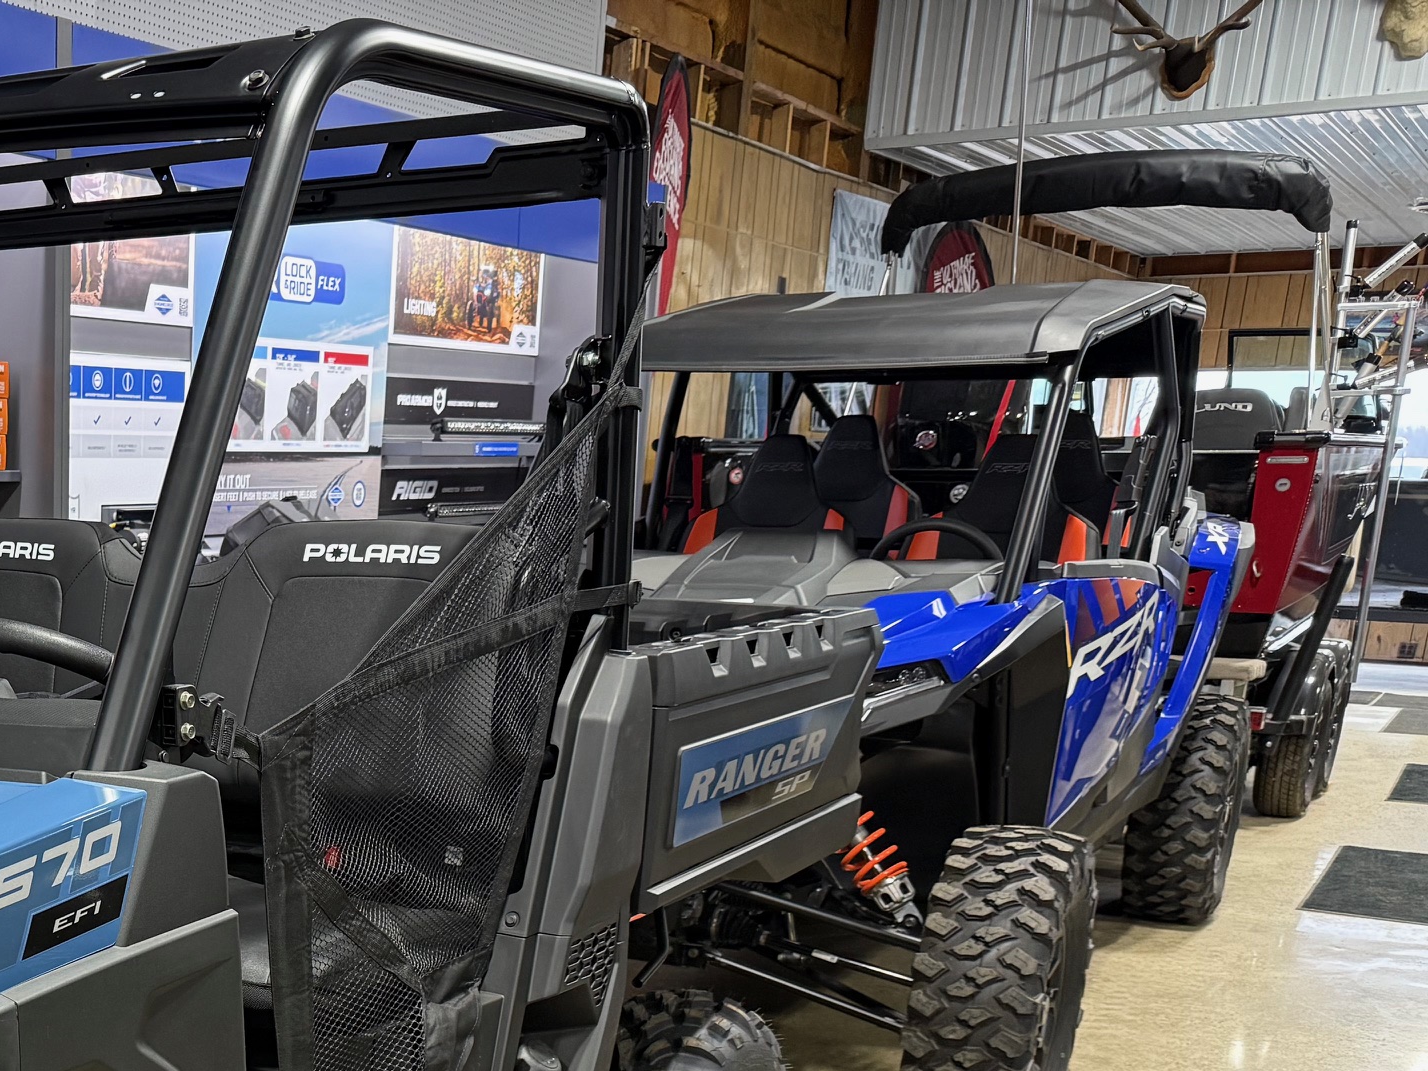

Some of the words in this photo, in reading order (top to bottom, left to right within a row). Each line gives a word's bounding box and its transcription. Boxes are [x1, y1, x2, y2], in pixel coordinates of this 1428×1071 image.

[284, 262, 312, 279] LOCK
[318, 275, 342, 292] FLEX
[404, 298, 436, 316] LIGHTING
[227, 475, 235, 488] IT
[235, 474, 251, 488] OUT
[392, 480, 438, 500] RIGID
[1207, 522, 1229, 555] XP
[302, 542, 442, 564] POLARIS
[1066, 588, 1160, 700] RZR
[683, 728, 827, 810] RANGER
[772, 770, 812, 800] SP
[52, 900, 101, 933] EFI
